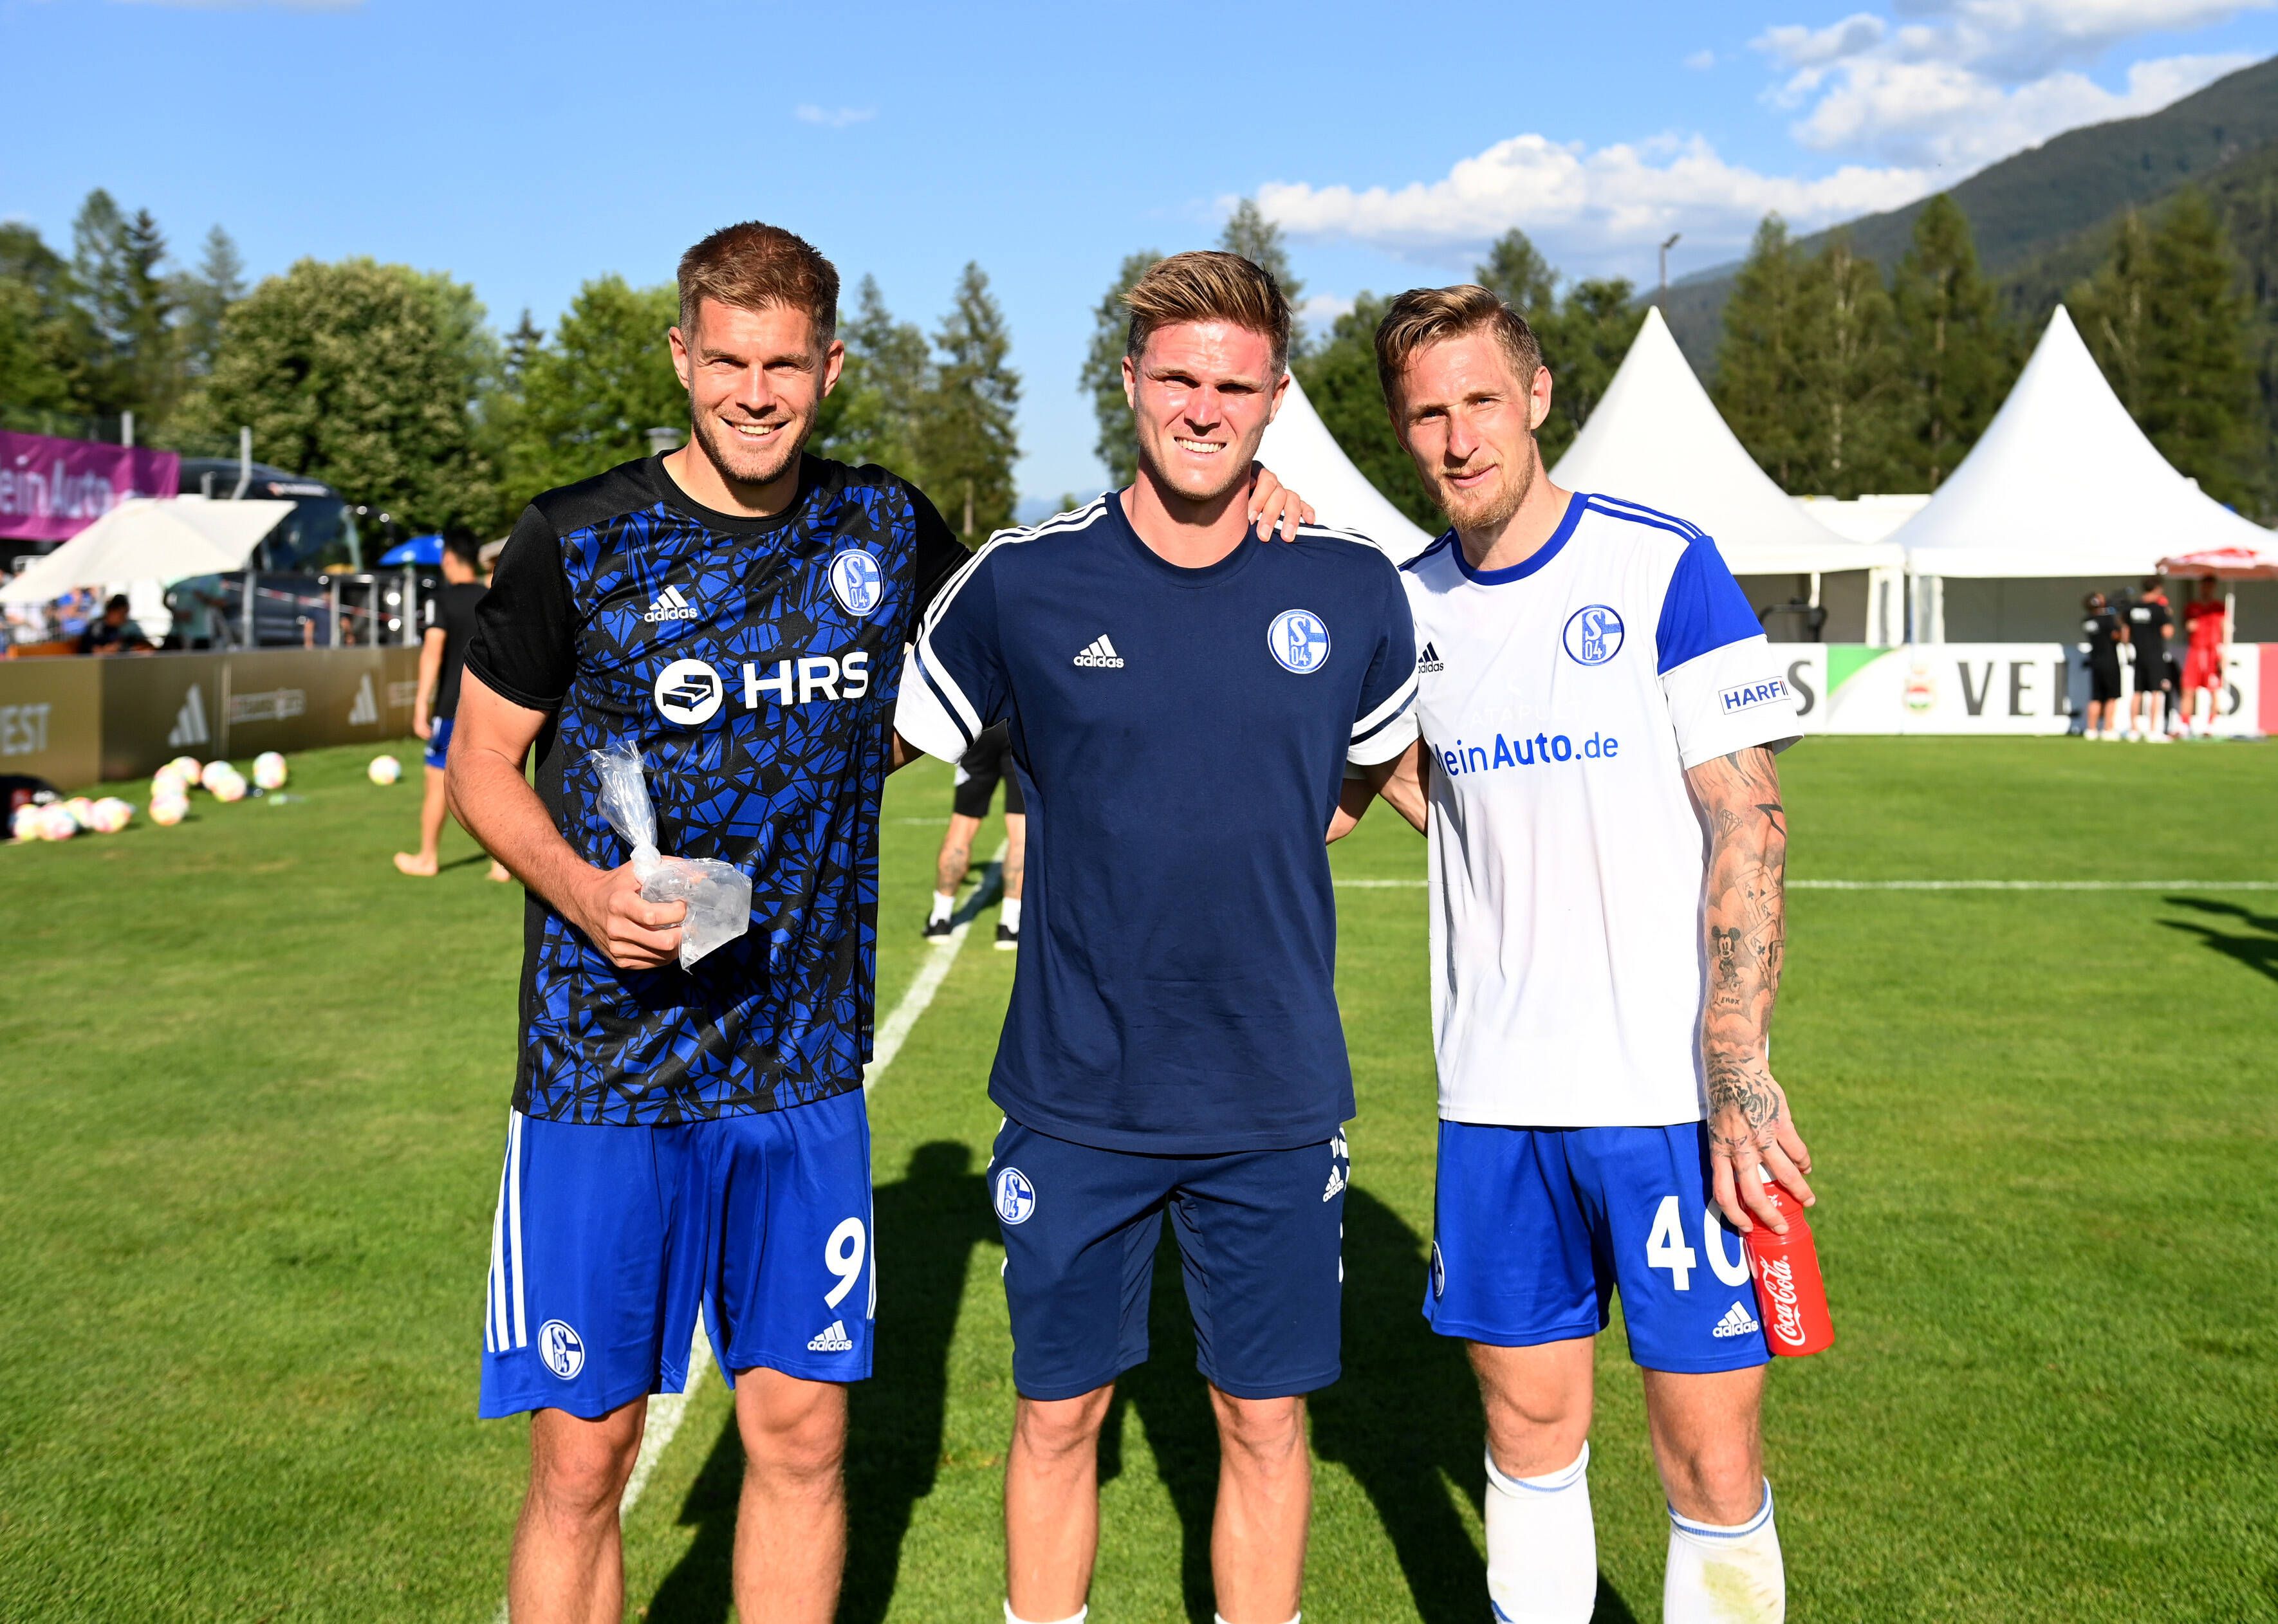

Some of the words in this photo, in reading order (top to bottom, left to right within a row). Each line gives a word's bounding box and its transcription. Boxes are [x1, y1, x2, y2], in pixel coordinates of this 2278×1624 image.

[851, 587, 867, 607] 04
[644, 607, 698, 622] adidas
[1292, 646, 1309, 666] 04
[1585, 640, 1603, 660] 04
[1073, 654, 1124, 668] adidas
[743, 651, 868, 709] HRS
[1724, 680, 1789, 710] HARFI
[1646, 1195, 1750, 1291] 40
[824, 1217, 866, 1310] 9
[1712, 1320, 1759, 1338] adidas
[807, 1339, 853, 1351] adidas
